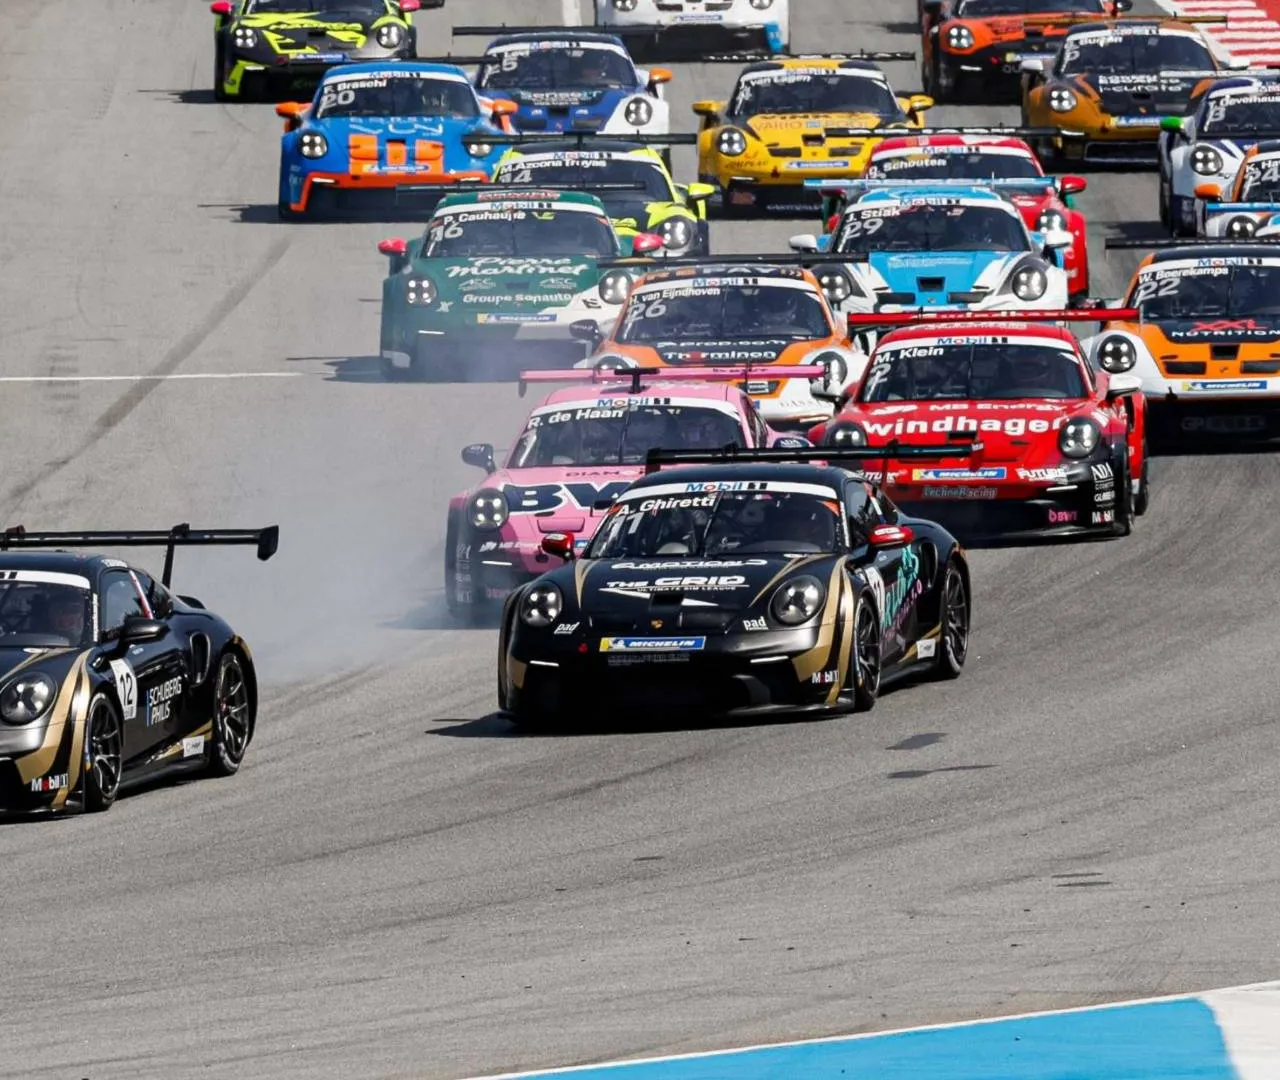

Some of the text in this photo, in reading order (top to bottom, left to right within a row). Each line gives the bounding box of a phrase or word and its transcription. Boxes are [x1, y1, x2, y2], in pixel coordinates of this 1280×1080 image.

[319, 90, 356, 110] 20
[883, 158, 947, 172] Schouten
[490, 201, 535, 211] Mobil
[899, 197, 943, 206] Mobil
[429, 221, 464, 242] 16
[1197, 257, 1245, 267] Mobil
[692, 277, 740, 287] Mobil
[1138, 273, 1154, 283] W.
[642, 291, 661, 301] van
[1133, 277, 1181, 303] 22
[462, 293, 513, 306] Groupe
[624, 299, 667, 324] 26
[937, 337, 988, 346] Mobil
[873, 346, 945, 365] M. Klein
[596, 396, 649, 407] Mobil
[929, 403, 1067, 412] MB Energy
[526, 406, 624, 429] R. de Haan
[861, 416, 1071, 437] windhager
[938, 469, 999, 478] MICHELIN
[684, 481, 743, 492] Mobil
[501, 481, 632, 513] BW
[617, 494, 716, 517] A. Ghiretti
[606, 575, 746, 588] THE GRID
[556, 621, 580, 633] pad
[742, 615, 767, 631] pad
[629, 639, 696, 648] MICHELIN
[119, 671, 133, 706] 12
[149, 675, 182, 707] SCHUBERG
[31, 775, 60, 792] Mobil
